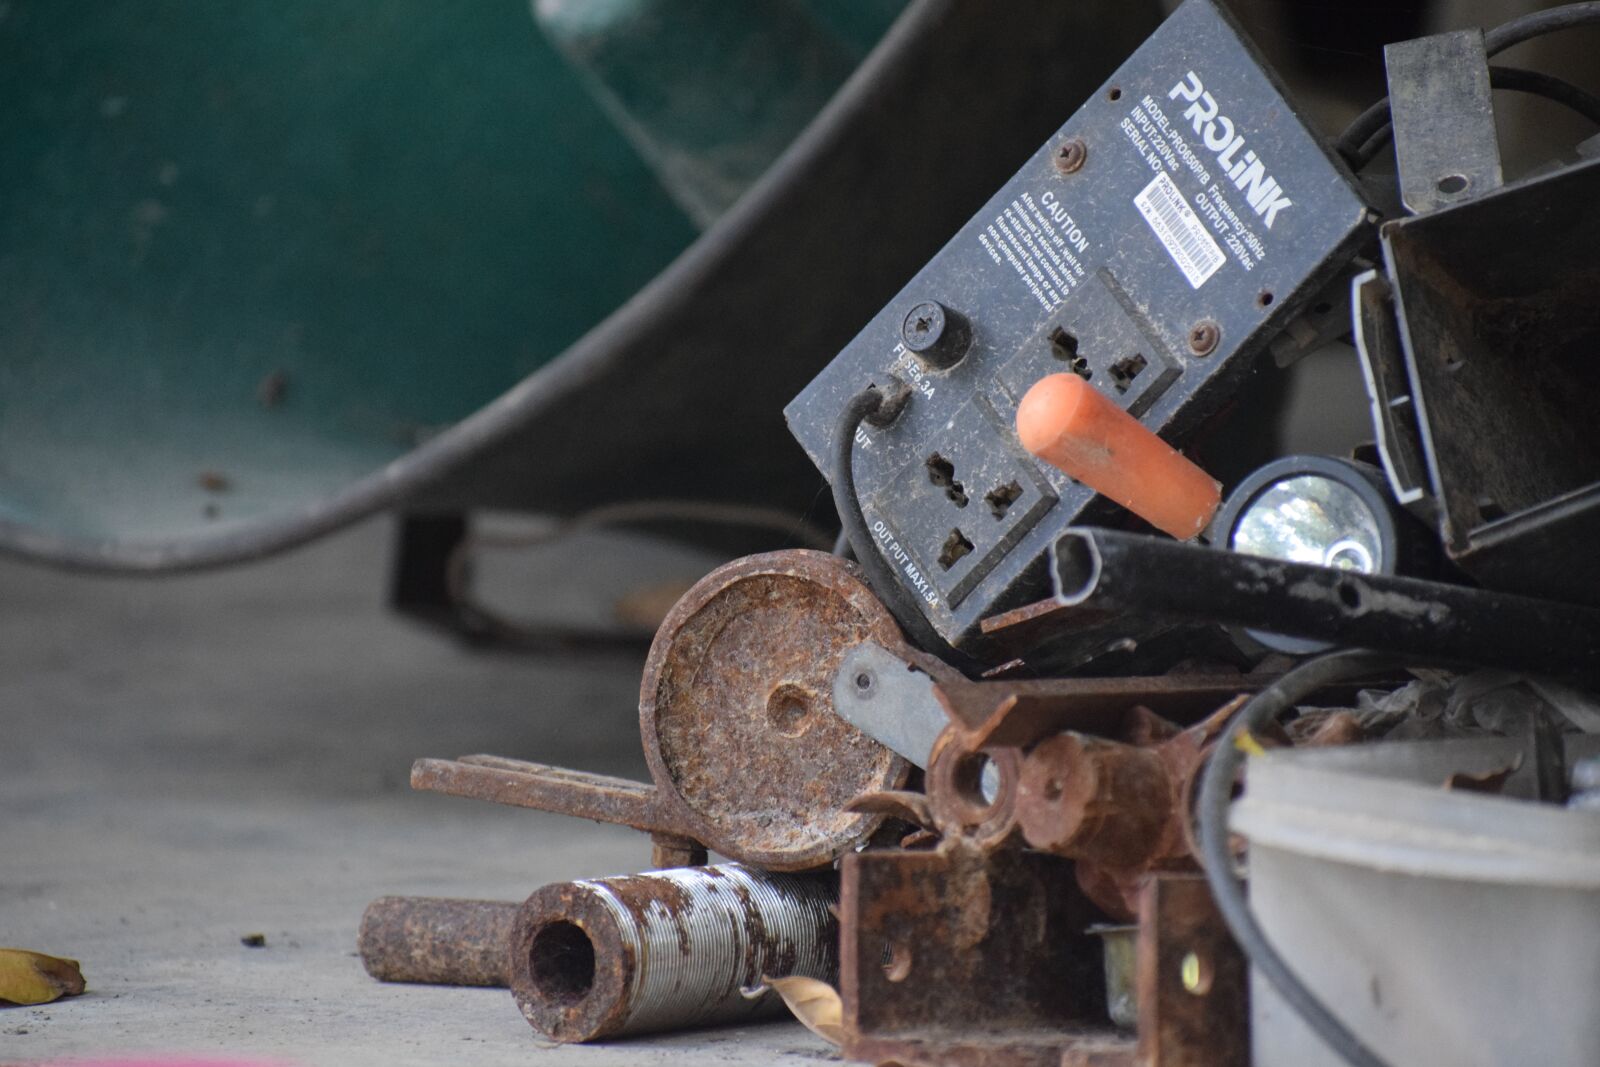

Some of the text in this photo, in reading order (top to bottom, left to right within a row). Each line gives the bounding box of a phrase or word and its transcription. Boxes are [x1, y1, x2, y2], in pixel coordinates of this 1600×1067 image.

[1120, 117, 1164, 175] SERIAL NO:
[1131, 105, 1180, 172] INPUT:220Vac
[1195, 192, 1230, 237] OUTPUT
[995, 216, 1062, 305] fluorescent lamps or any
[1011, 200, 1077, 287] minimum 2 seconds before
[1021, 192, 1038, 212] After
[1034, 211, 1055, 237] switch
[1075, 264, 1085, 276] for
[1041, 191, 1089, 253] CAUTION
[1208, 184, 1266, 261] Frequency:50Hz
[1022, 274, 1054, 312] peripheral
[1031, 245, 1043, 259] not
[1041, 257, 1065, 287] connect
[1061, 284, 1070, 295] to
[873, 520, 939, 609] OUT PUT MAX1.5A
